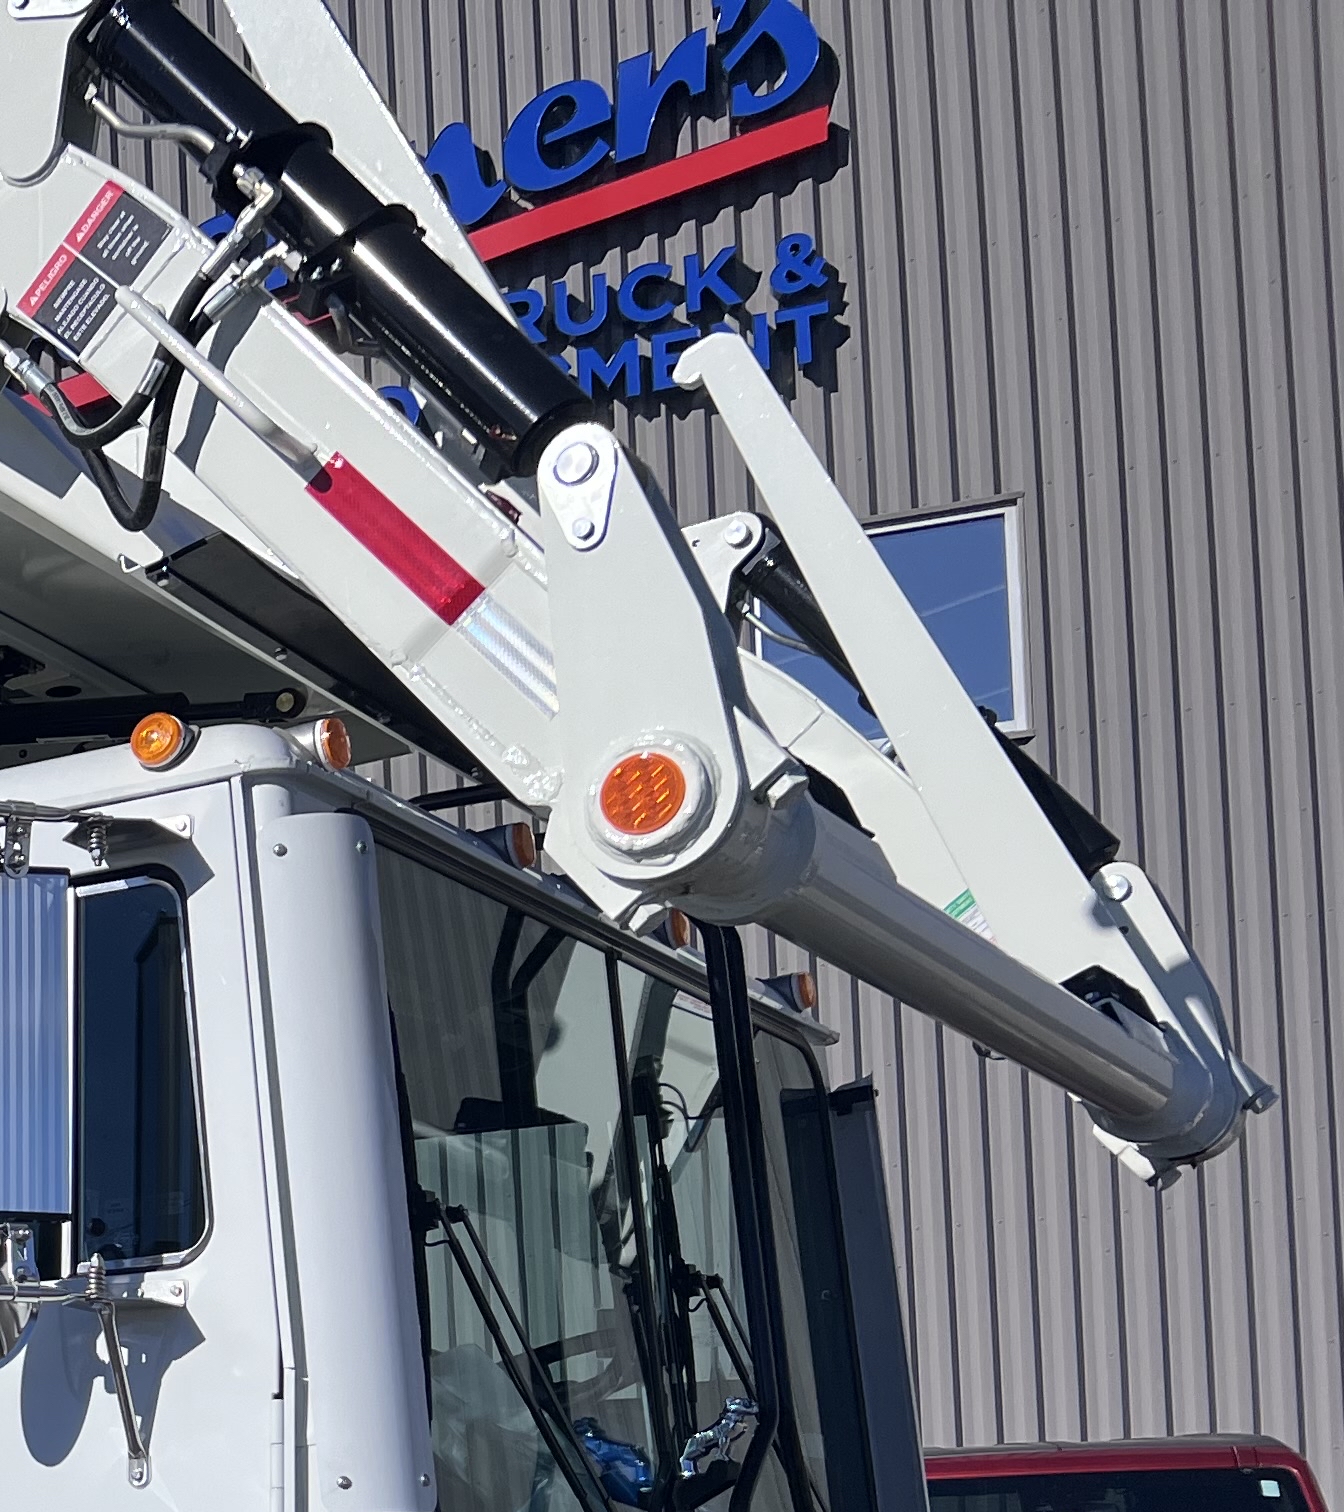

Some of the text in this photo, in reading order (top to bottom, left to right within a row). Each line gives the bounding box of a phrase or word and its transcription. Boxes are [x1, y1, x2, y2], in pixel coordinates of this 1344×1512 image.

[81, 189, 115, 235] DANGER
[35, 253, 68, 298] PELIGRO
[503, 233, 829, 344] RUCK &
